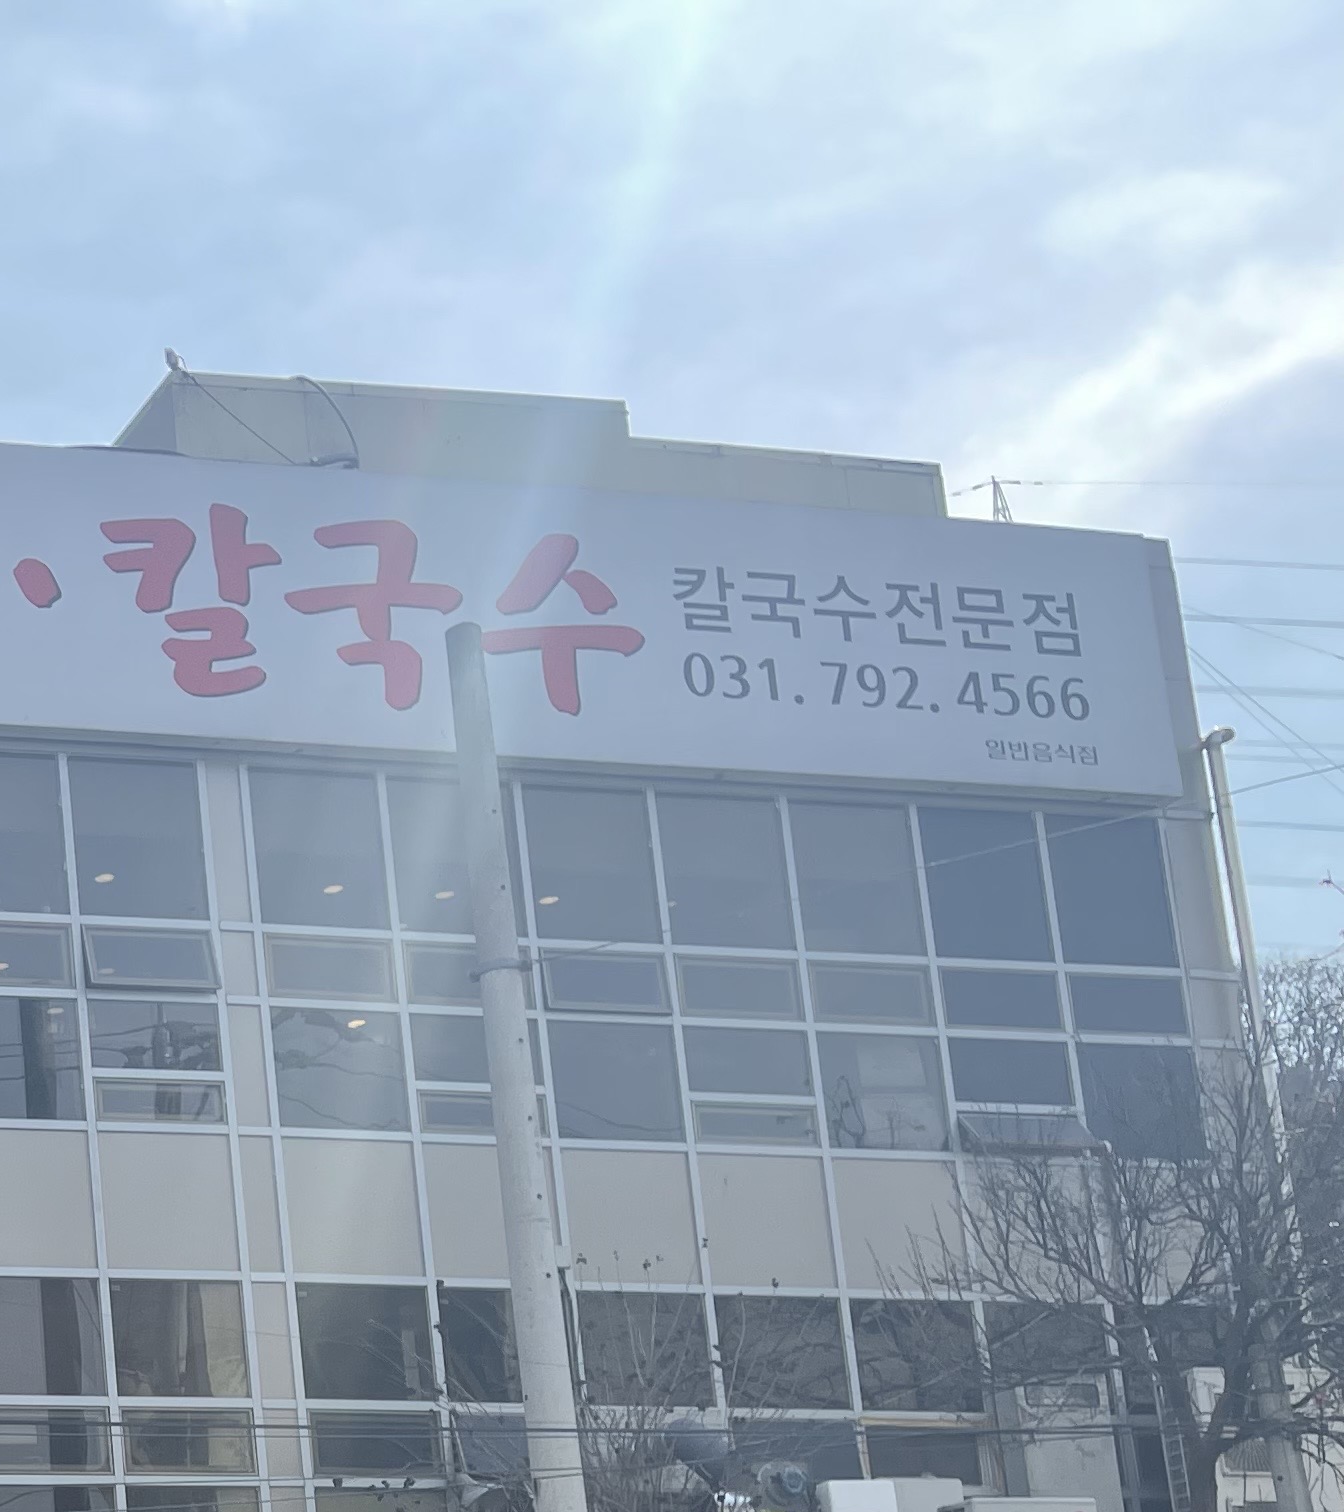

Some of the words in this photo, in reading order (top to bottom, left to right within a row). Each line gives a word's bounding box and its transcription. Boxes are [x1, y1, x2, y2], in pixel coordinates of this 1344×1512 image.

[100, 503, 645, 716] 칼국수
[672, 566, 1083, 657] 칼국수전문점
[683, 652, 1090, 721] 031.792.4566
